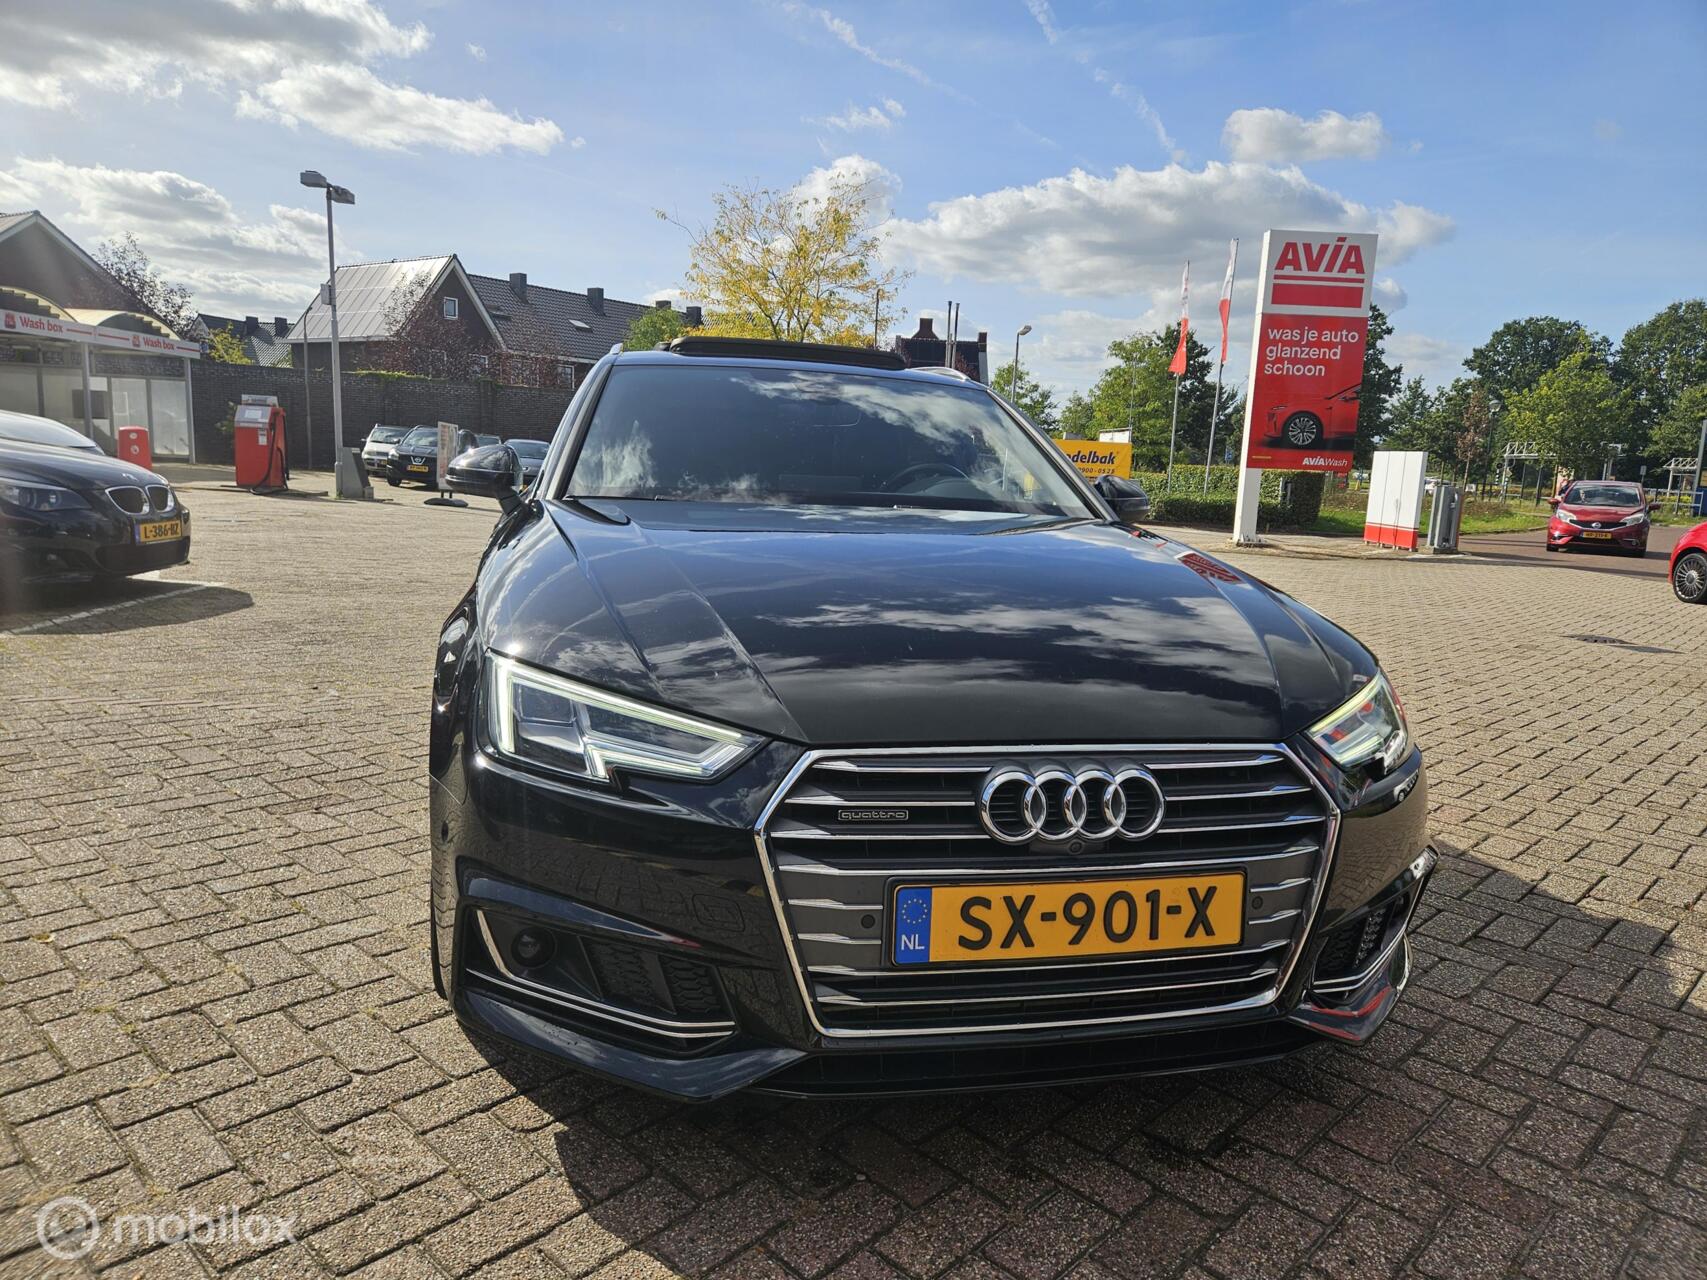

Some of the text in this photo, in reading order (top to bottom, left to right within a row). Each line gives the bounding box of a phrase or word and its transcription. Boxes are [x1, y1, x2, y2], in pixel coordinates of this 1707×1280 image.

[19, 314, 64, 333] Wash box
[143, 336, 175, 350] Wash box
[1268, 326, 1359, 344] was je auto
[1265, 342, 1342, 361] glanzend
[1264, 360, 1325, 376] schoon
[841, 811, 905, 820] quattro
[958, 886, 1217, 951] SX-901-X
[901, 933, 926, 950] NL
